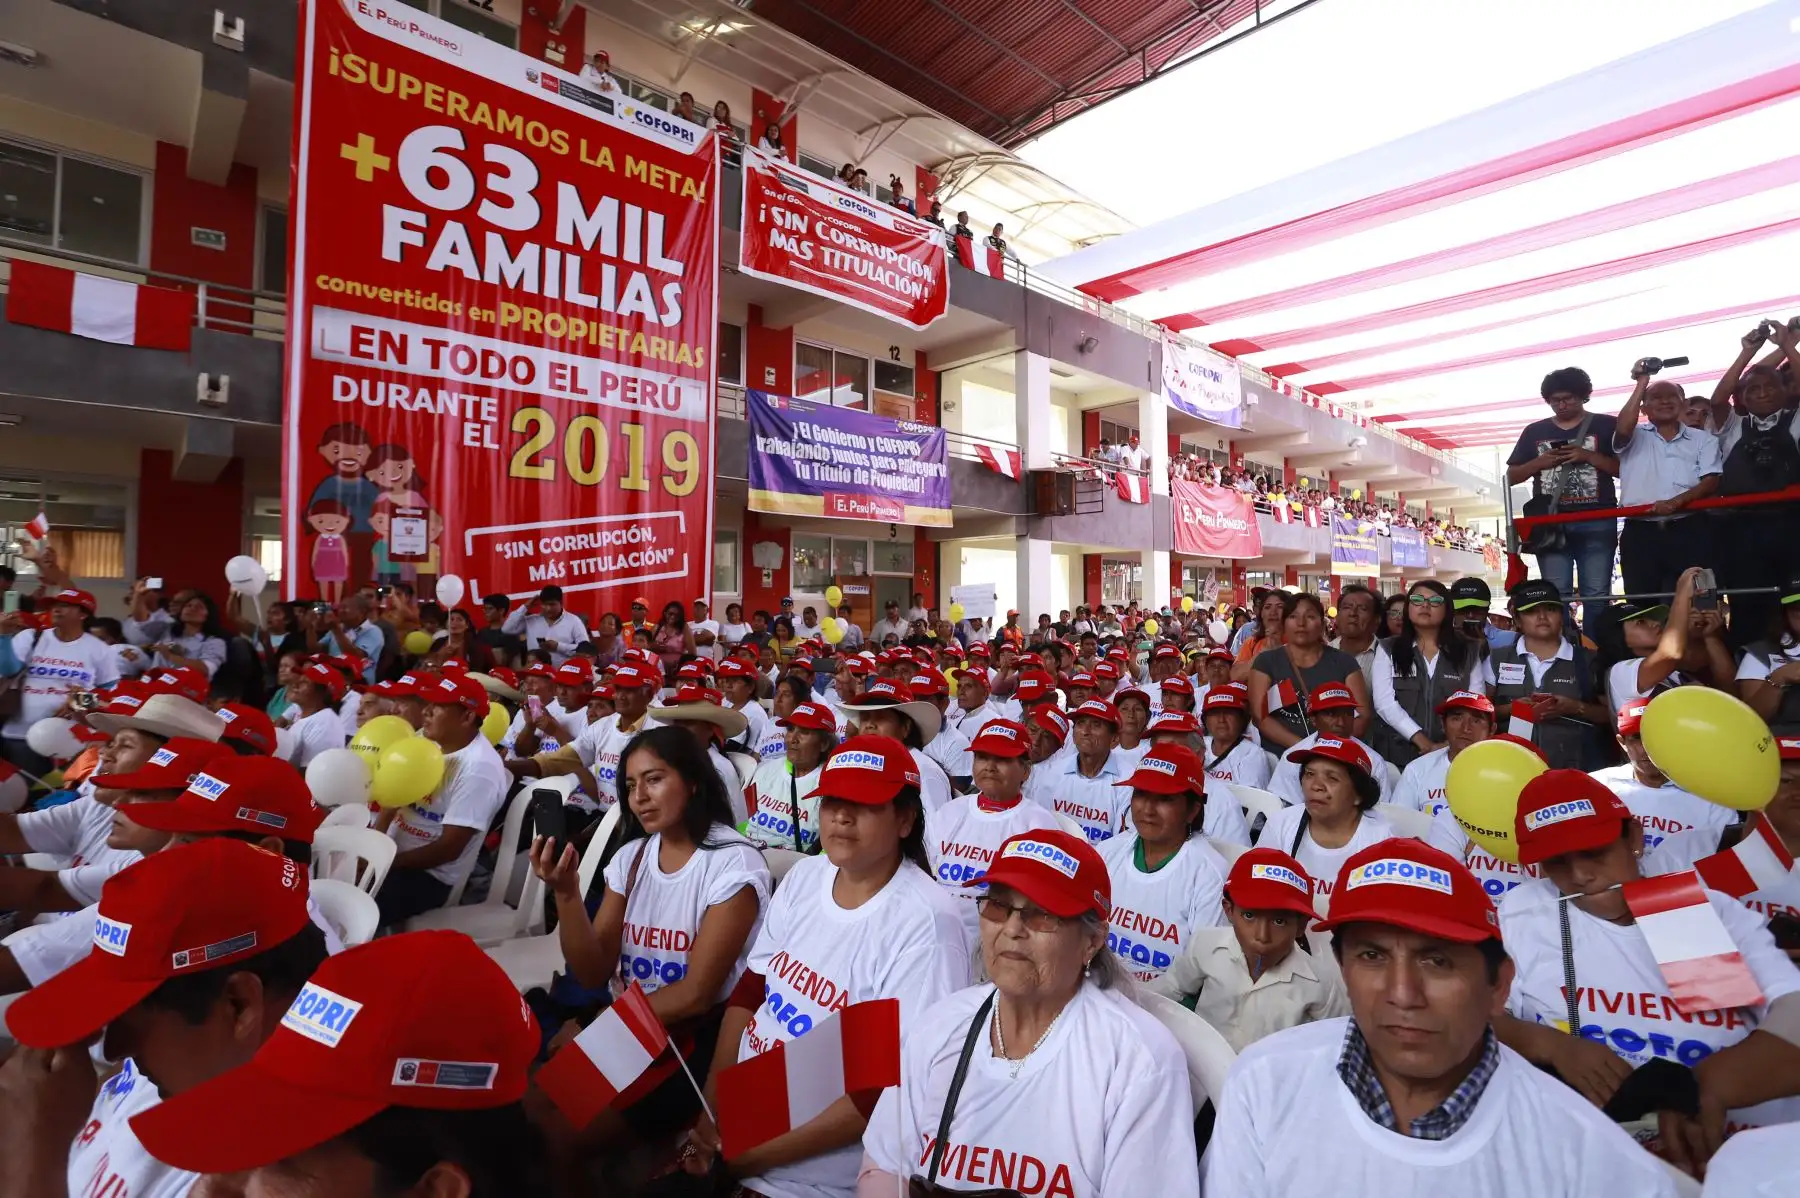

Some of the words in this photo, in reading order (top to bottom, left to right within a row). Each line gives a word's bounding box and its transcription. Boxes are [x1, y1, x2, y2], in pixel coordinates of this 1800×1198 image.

[410, 22, 458, 51] PRIMERO
[328, 47, 570, 156] ¡SUPERAMOS
[580, 139, 616, 173] LA
[624, 155, 707, 204] META!
[634, 109, 694, 143] COFOPRI
[838, 197, 877, 219] COFOPRI
[555, 181, 685, 277] MIL
[769, 228, 815, 261] MÁS
[382, 204, 683, 328] FAMILIAS
[316, 273, 462, 318] convertidas
[468, 306, 496, 325] en
[499, 302, 706, 370] PROPIETARIAS
[349, 324, 409, 366] EN
[422, 337, 536, 387] TODO
[548, 362, 589, 396] EL
[600, 376, 682, 412] PERÚ
[889, 345, 901, 361] 12
[332, 375, 499, 424] DURANTE
[463, 421, 500, 451] EL
[813, 423, 867, 450] Gobierno
[868, 436, 877, 453] y
[876, 434, 921, 457] COFOPRI
[508, 406, 701, 498] 2019
[756, 434, 831, 463] trabajando
[831, 446, 870, 468] juntos
[870, 455, 898, 471] para
[793, 461, 811, 480] Tu
[811, 462, 851, 484] Título
[853, 469, 869, 486] de
[837, 498, 849, 513] EL
[869, 502, 898, 518] PRIMERO
[538, 525, 657, 555] CORRUPCIÓN,
[889, 523, 897, 538] 5
[528, 558, 566, 583] MÁS
[569, 545, 675, 577] TITULACIÓN”
[835, 753, 884, 767] COFOPRI
[1535, 800, 1593, 823] COFOPRI
[1016, 841, 1077, 872] COFOPRI
[1265, 866, 1307, 890] COFOPRI
[1364, 862, 1449, 887] COFOPRI
[1106, 932, 1172, 969] OFOP
[621, 954, 689, 985] COFO
